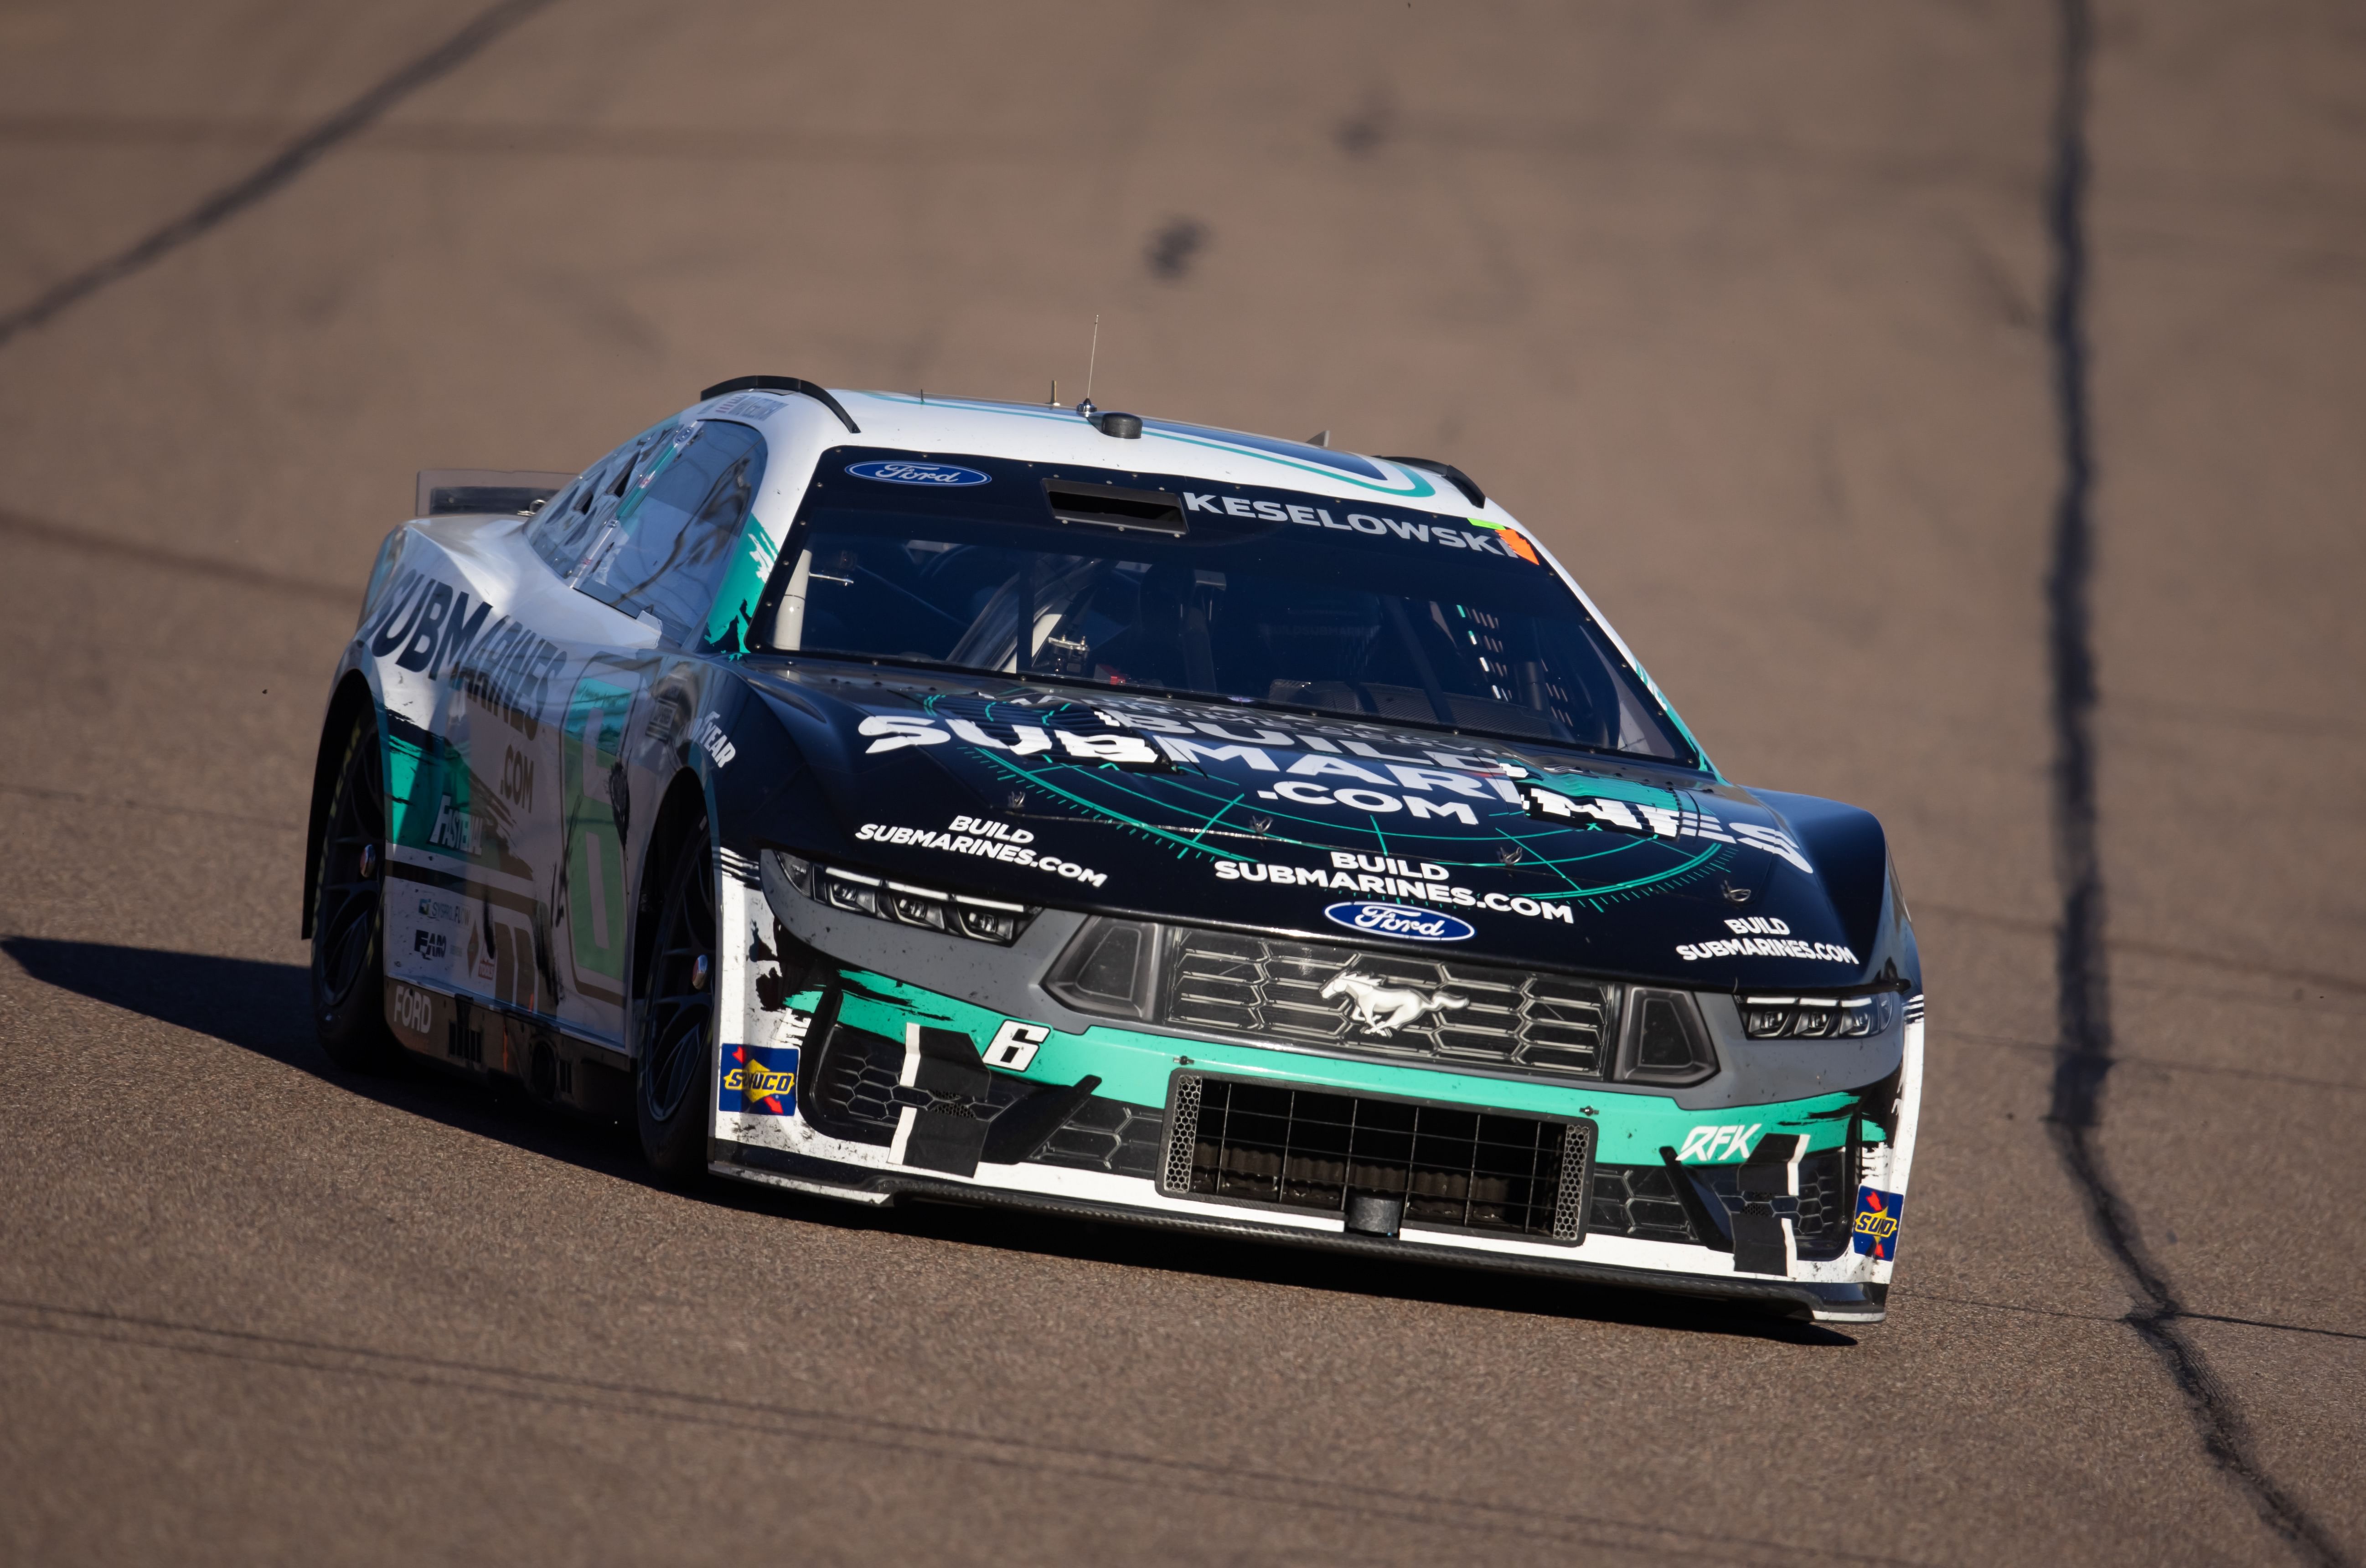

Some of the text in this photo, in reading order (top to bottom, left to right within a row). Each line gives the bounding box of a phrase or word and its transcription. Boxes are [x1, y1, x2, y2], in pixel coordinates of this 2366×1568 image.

[875, 462, 961, 483] Ford
[1183, 491, 1519, 558] KESELOWSKI
[1093, 708, 1529, 778] BUILD
[500, 743, 534, 814] .COM
[858, 715, 1814, 874] SUBMARINES
[1257, 781, 1478, 825] .COM
[948, 815, 1034, 844] BUILD
[855, 823, 1108, 887] SUBMARINES.COM
[1330, 851, 1449, 881] BUILD
[1215, 860, 1575, 924] SUBMARINES.COM
[1355, 902, 1446, 938] Ford
[1724, 917, 1791, 936] BUILD
[1676, 937, 1860, 965] SUBMARINES.COM
[393, 985, 432, 1033] FORD
[983, 1019, 1051, 1072] 6
[1675, 1123, 1762, 1161] RFK
